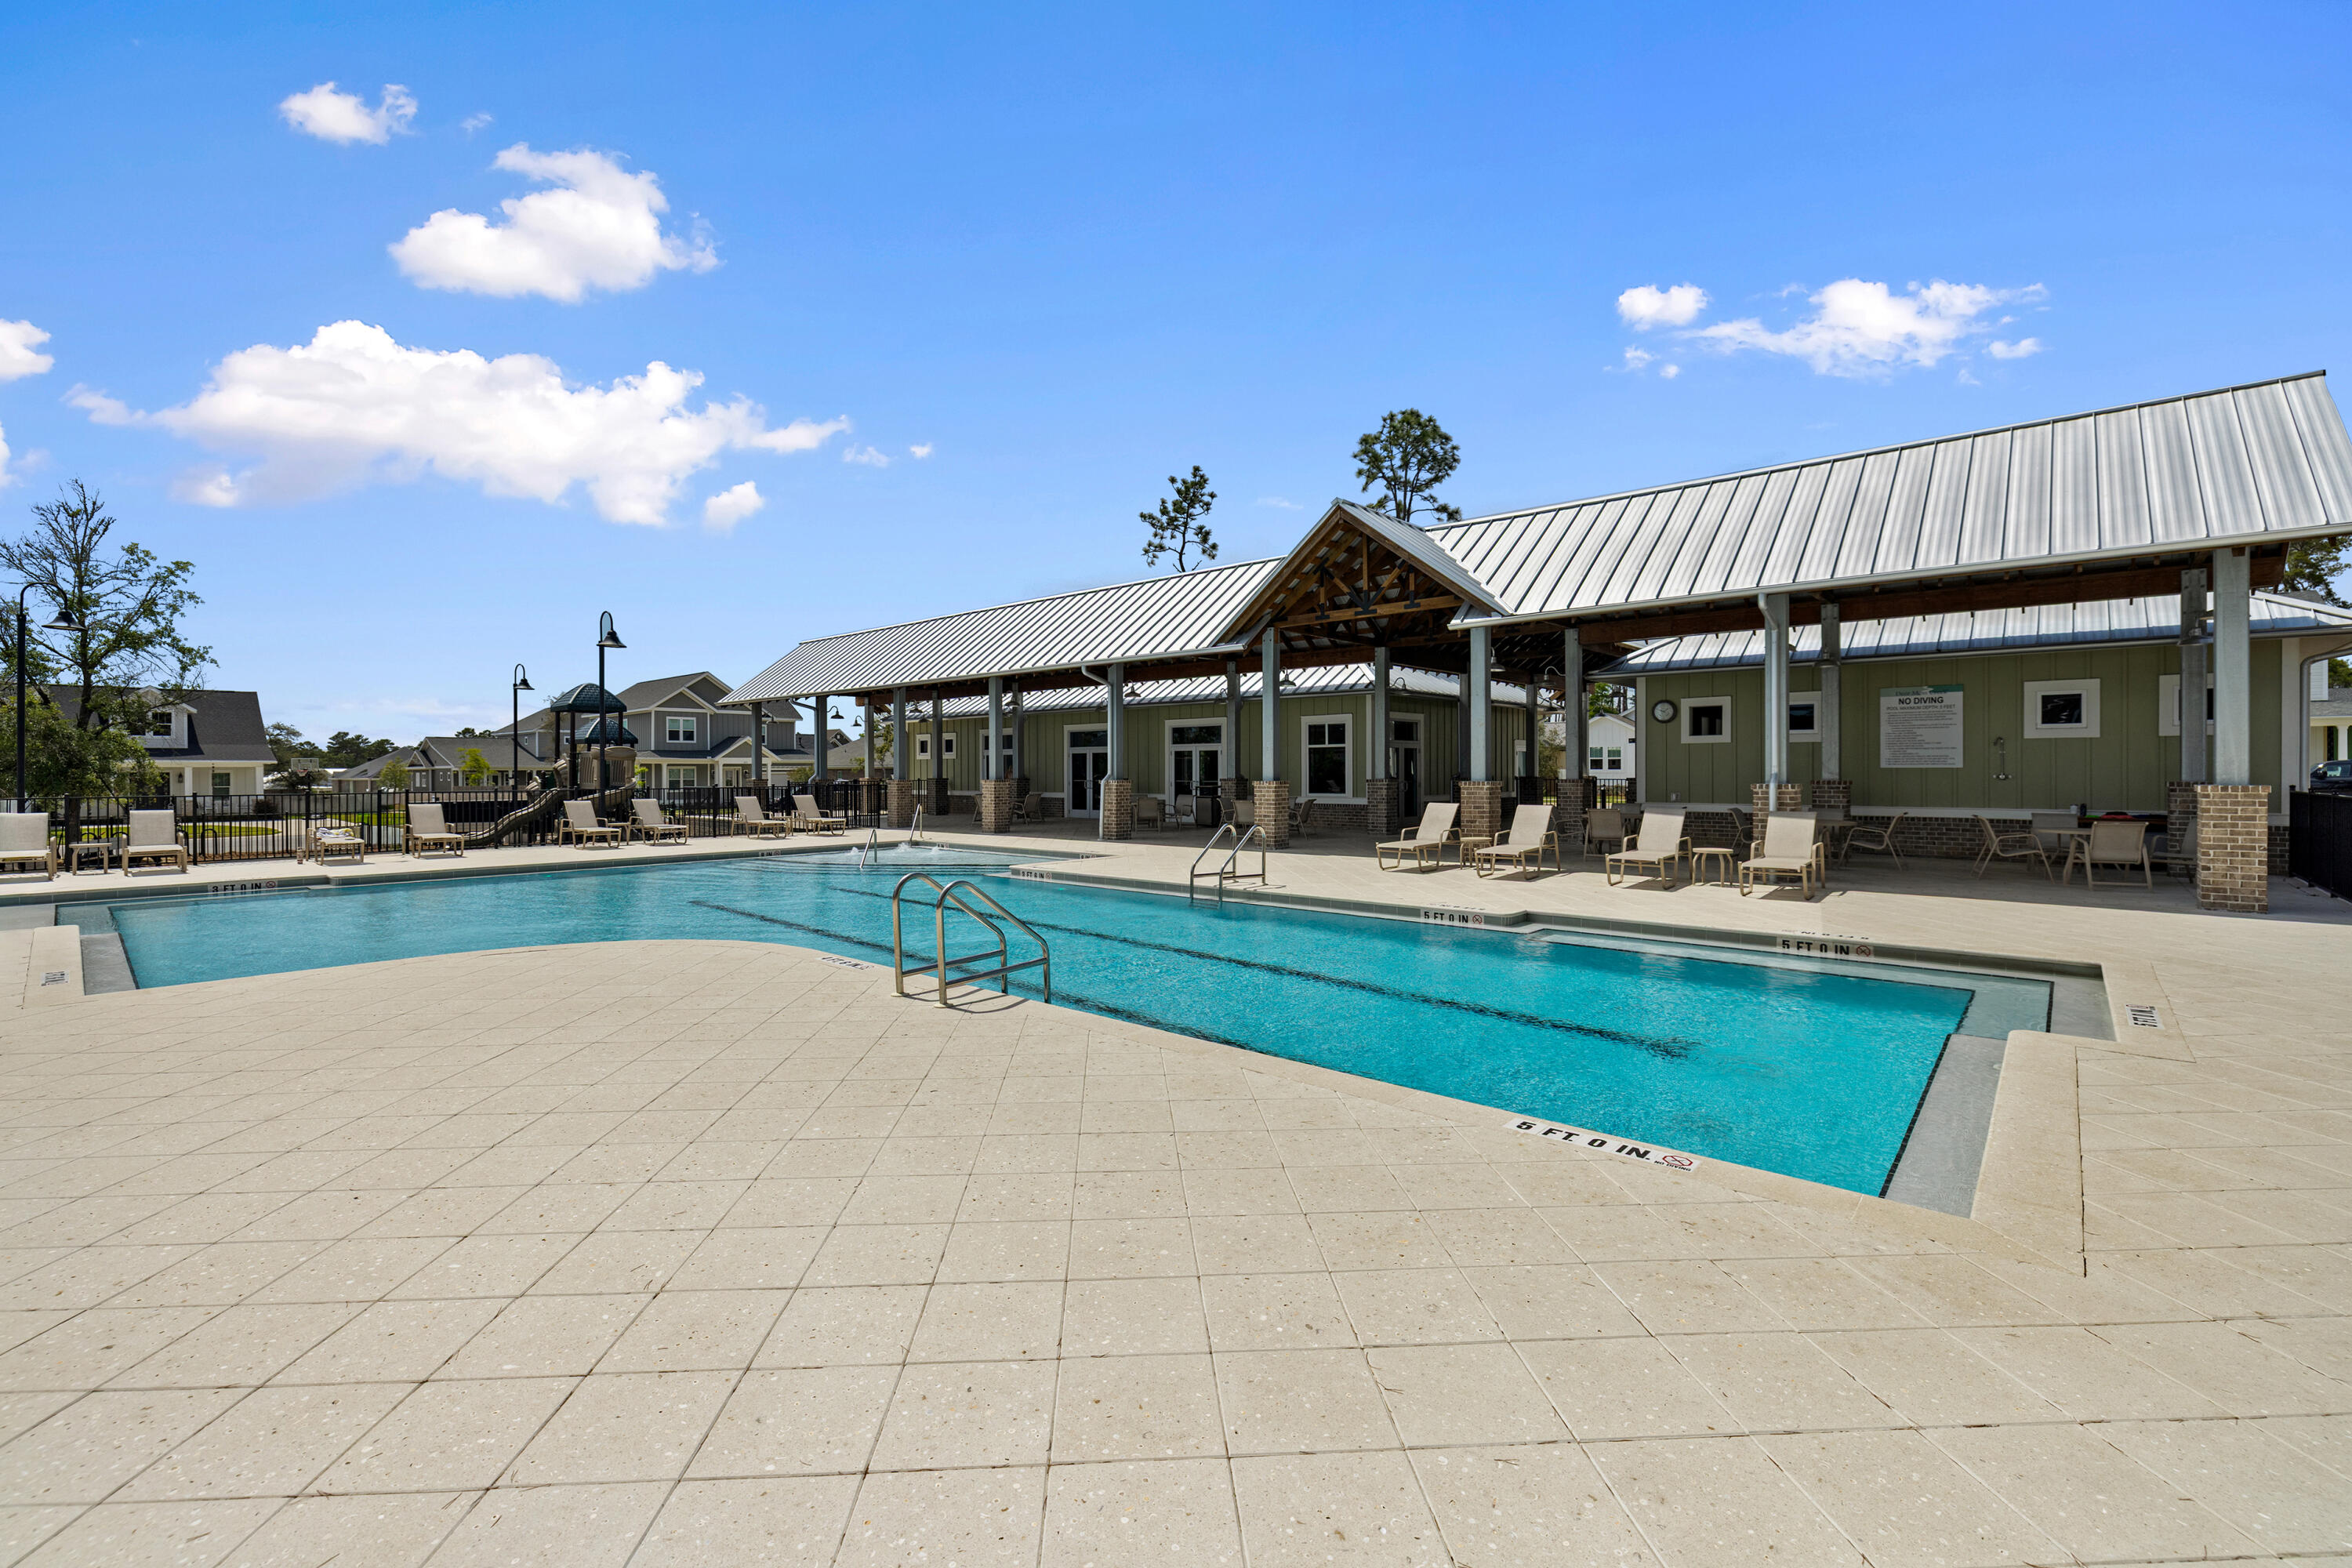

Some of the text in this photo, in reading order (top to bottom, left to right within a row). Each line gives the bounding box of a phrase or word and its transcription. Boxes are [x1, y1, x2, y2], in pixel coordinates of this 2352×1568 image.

[1914, 696, 1944, 705] DIVING
[1458, 914, 1468, 923] IN
[1782, 940, 1790, 949] 5
[1796, 941, 1813, 951] FT
[1835, 945, 1849, 955] IN
[1515, 1121, 1651, 1160] 5 FT. 0 IN.
[1666, 1163, 1692, 1172] DIVING
